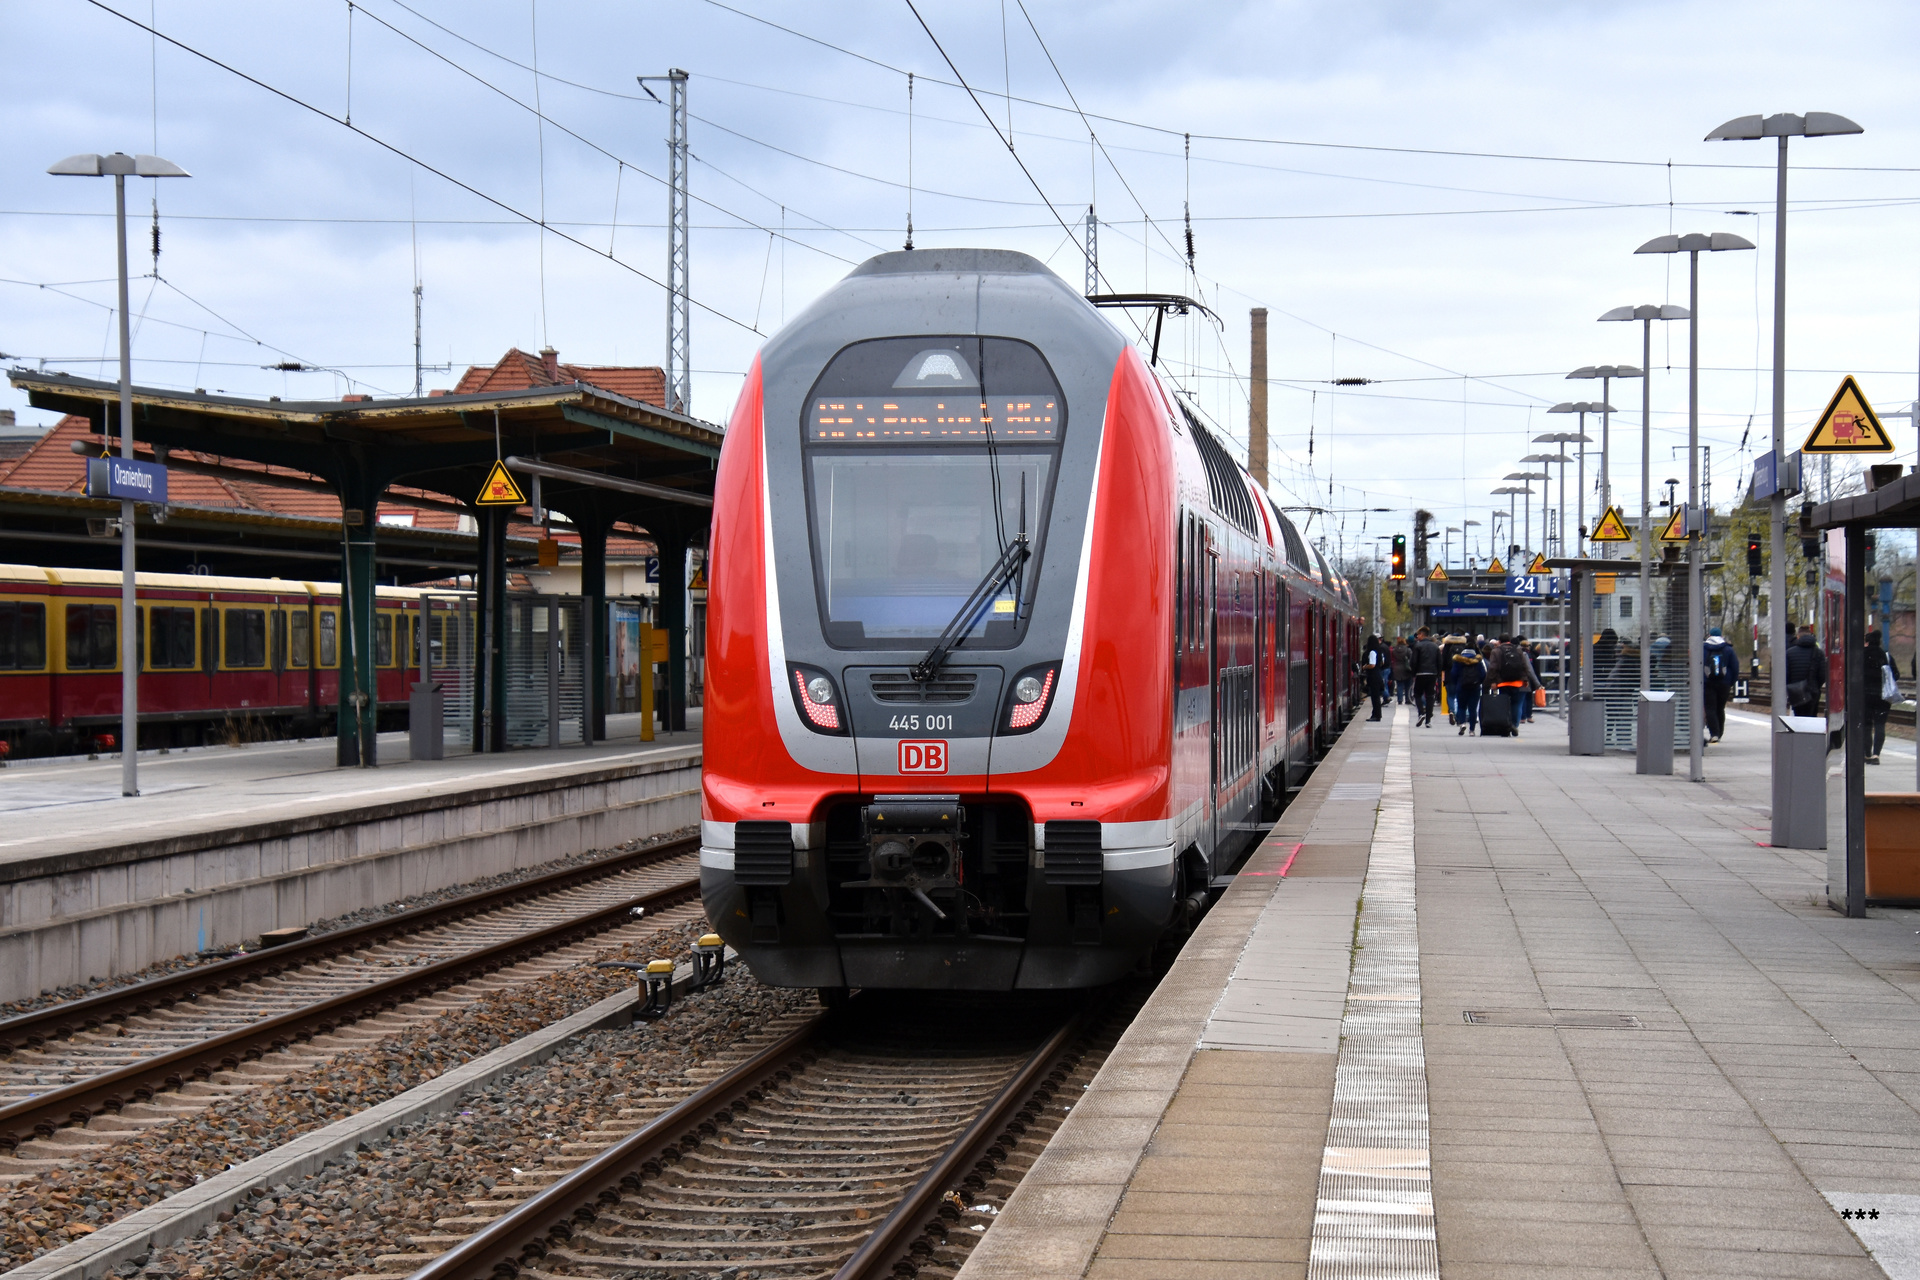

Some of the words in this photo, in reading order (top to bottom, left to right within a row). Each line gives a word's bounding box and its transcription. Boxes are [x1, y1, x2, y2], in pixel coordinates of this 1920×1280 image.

[114, 464, 152, 494] Oranienburg
[1514, 577, 1535, 594] 24
[889, 715, 920, 730] 445
[926, 715, 952, 730] 001
[905, 745, 943, 769] DB
